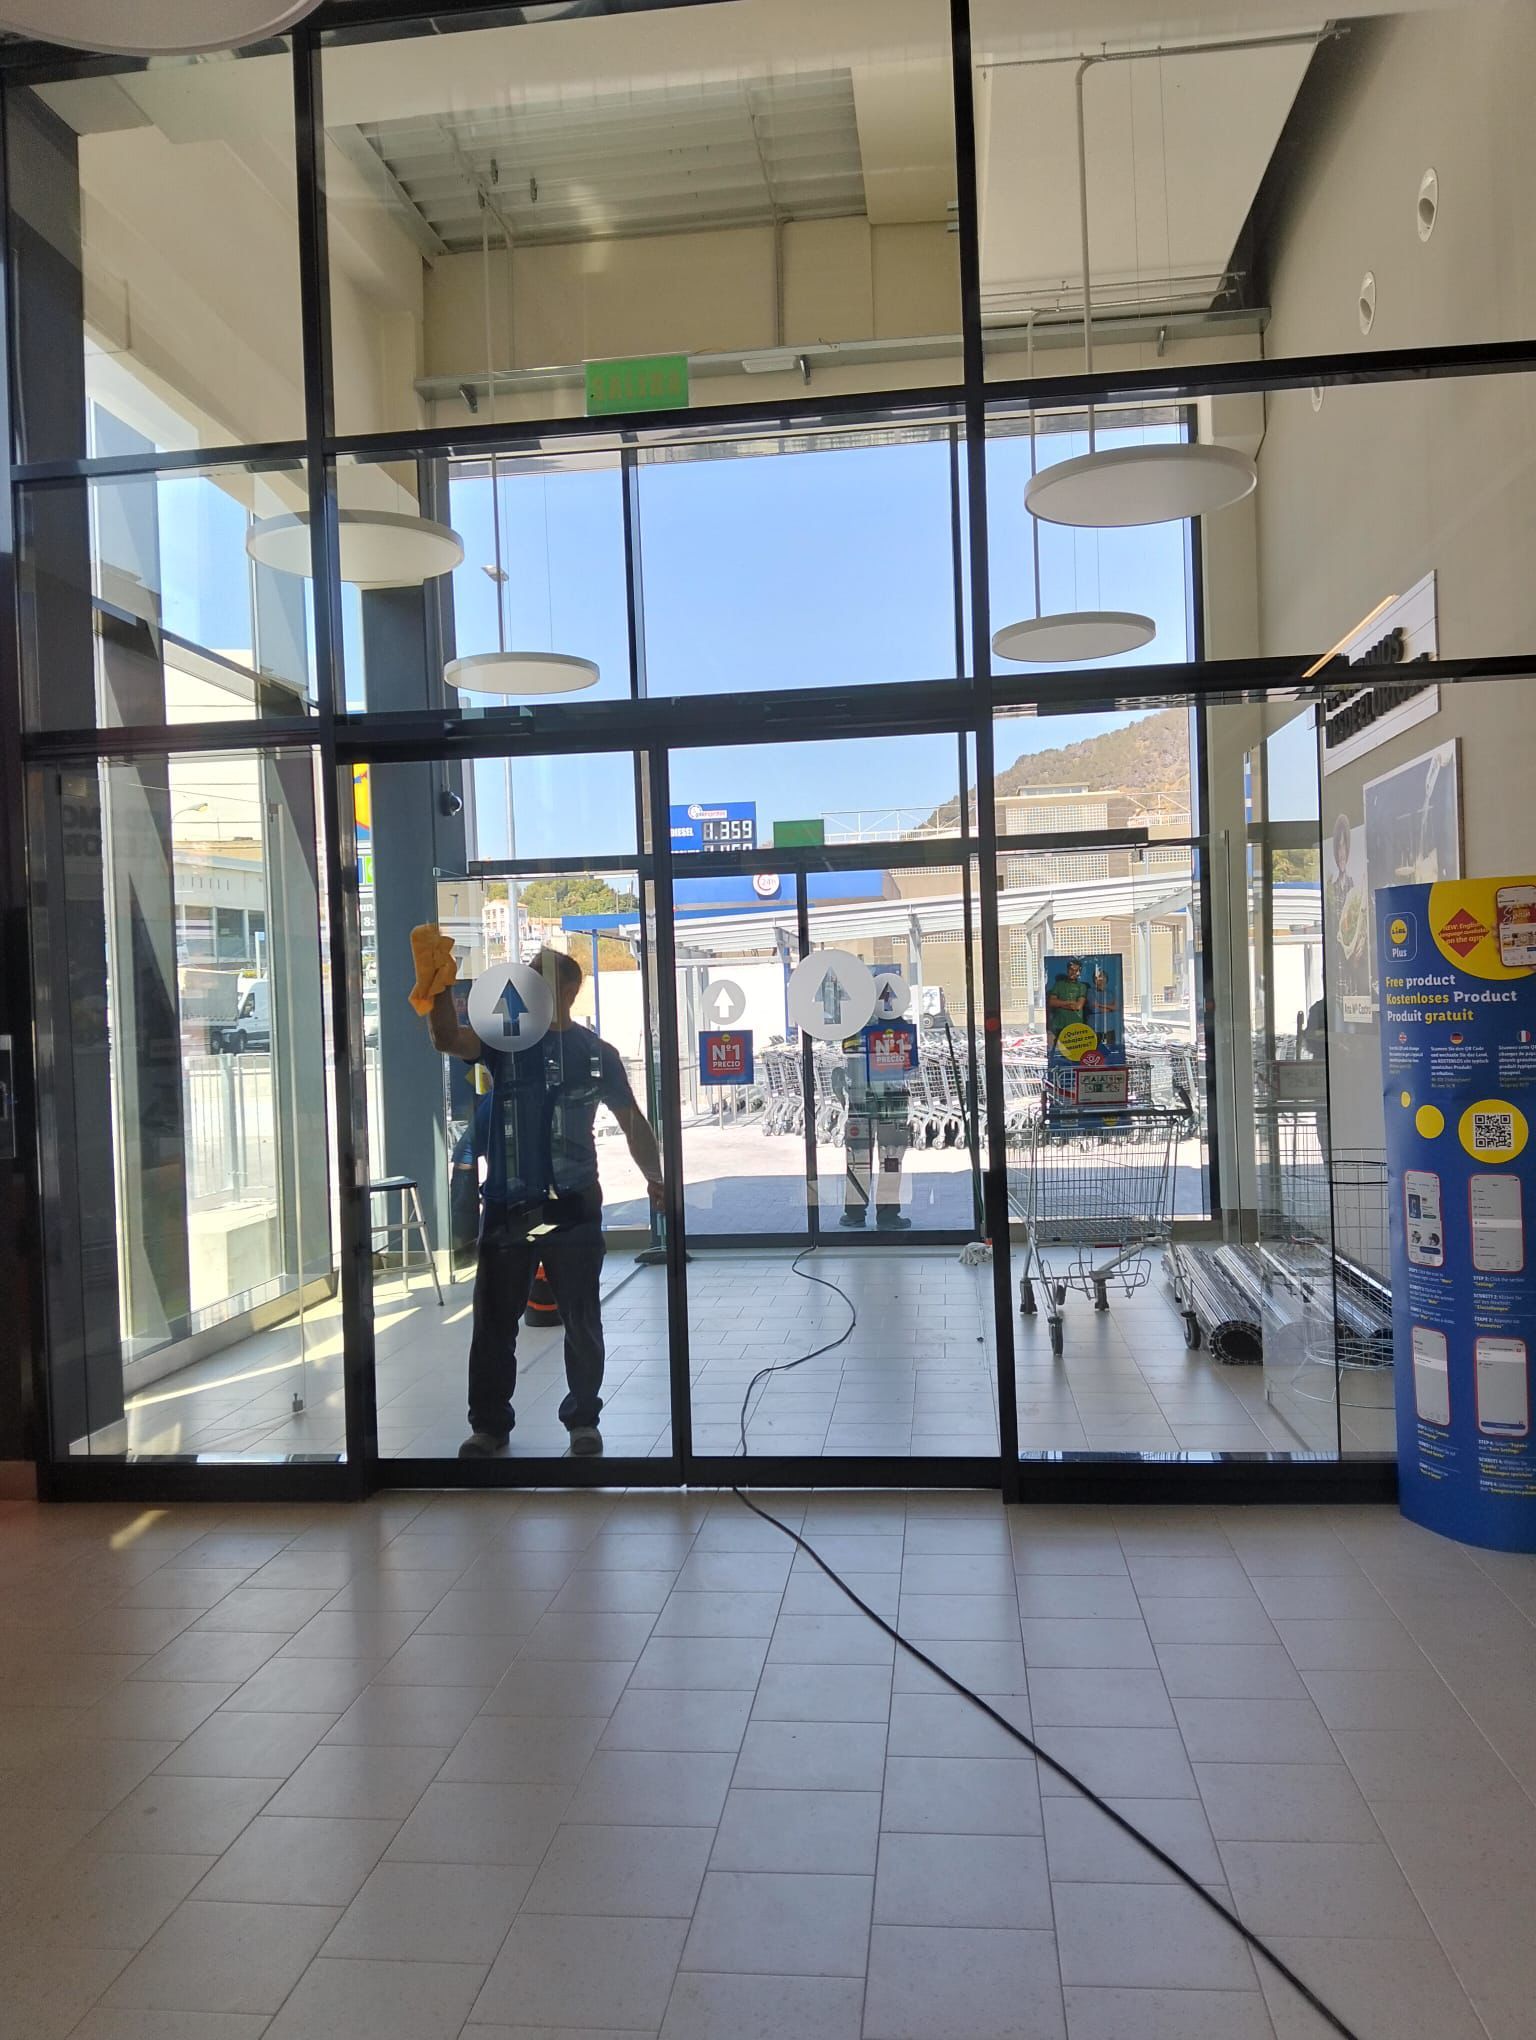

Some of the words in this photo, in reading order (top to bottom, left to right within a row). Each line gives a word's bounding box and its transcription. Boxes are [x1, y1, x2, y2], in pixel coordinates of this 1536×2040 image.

[590, 368, 682, 401] SALIDA
[670, 827, 694, 837] DIESEL
[708, 820, 752, 840] 1.359
[1392, 948, 1407, 958] Plus
[1385, 976, 1404, 988] Free
[1406, 974, 1456, 990] product
[1386, 992, 1450, 1005] Kostenloses
[1453, 990, 1518, 1003] Product
[1387, 1010, 1422, 1022] Produit
[1424, 1008, 1474, 1024] gratuit
[876, 1055, 906, 1064] PRECIO
